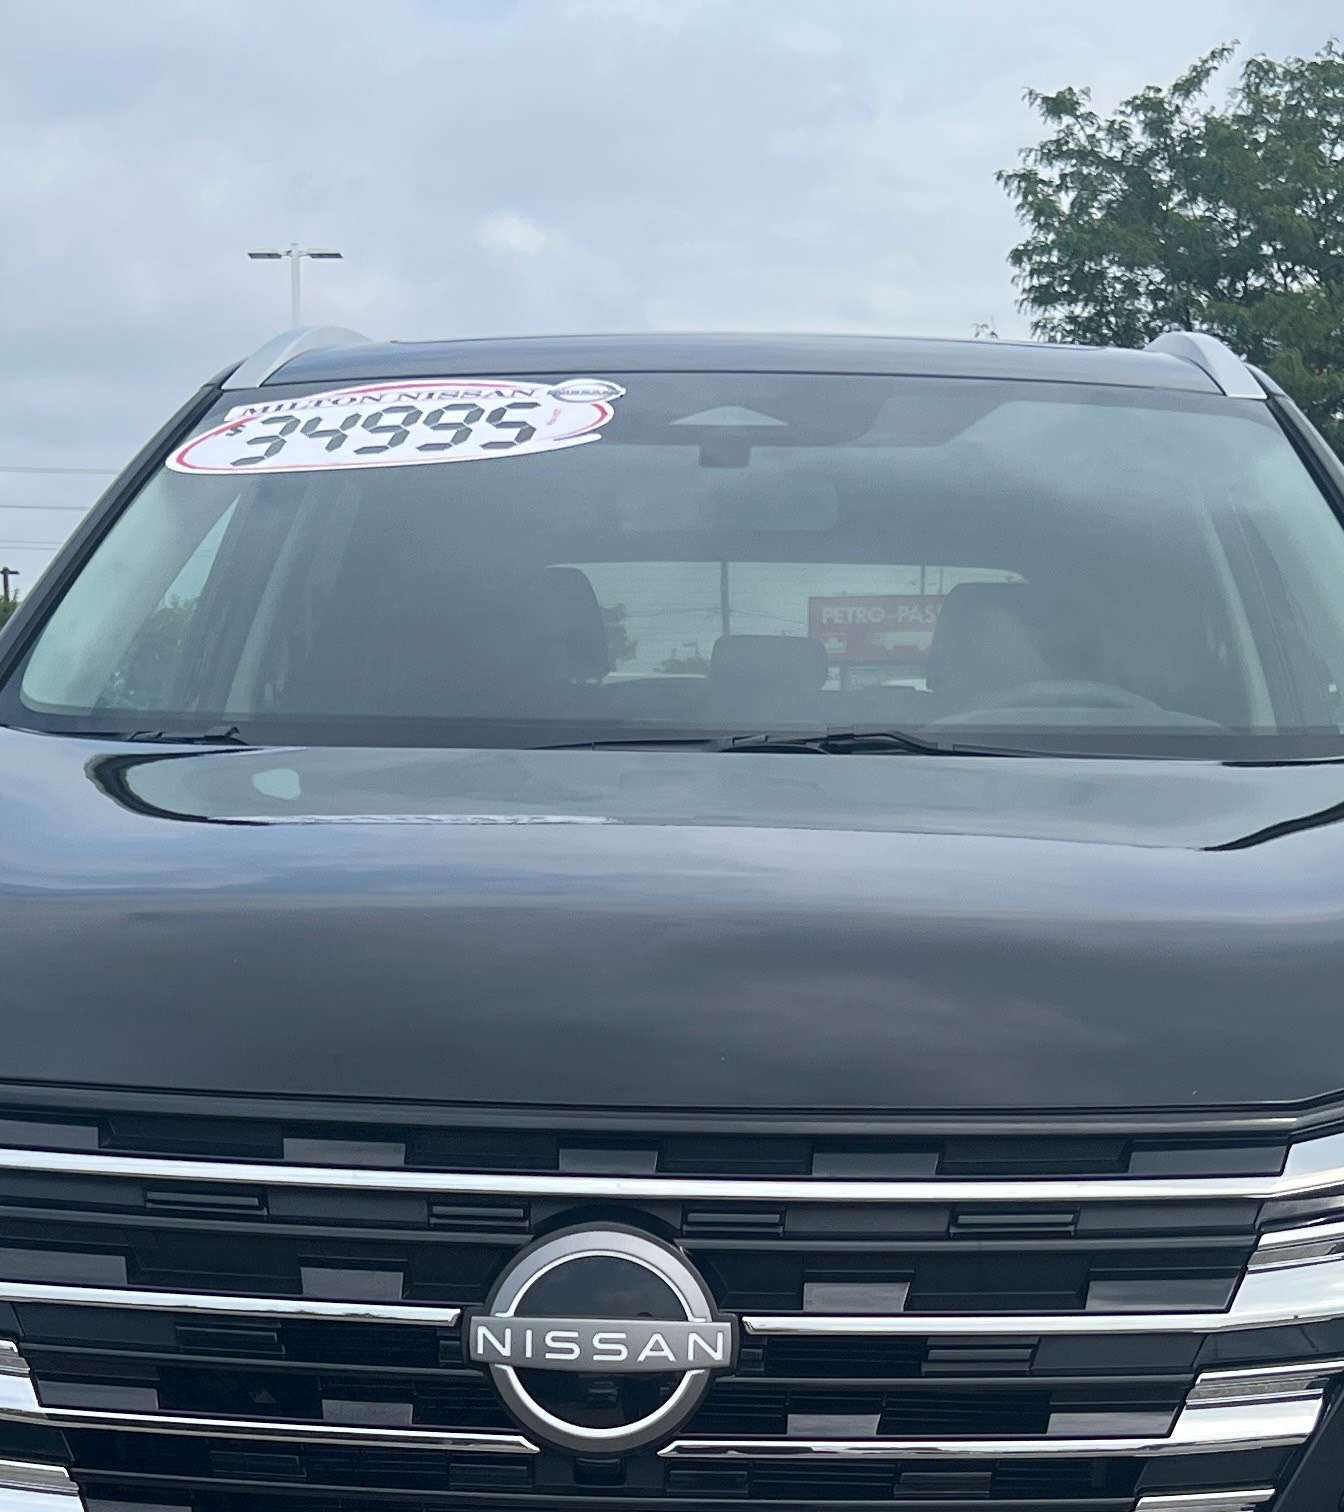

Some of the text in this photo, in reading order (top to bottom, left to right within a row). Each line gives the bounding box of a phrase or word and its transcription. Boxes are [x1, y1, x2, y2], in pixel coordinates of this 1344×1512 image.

[241, 388, 537, 416] MILTON NISSAN
[476, 1325, 723, 1362] NISSAN
